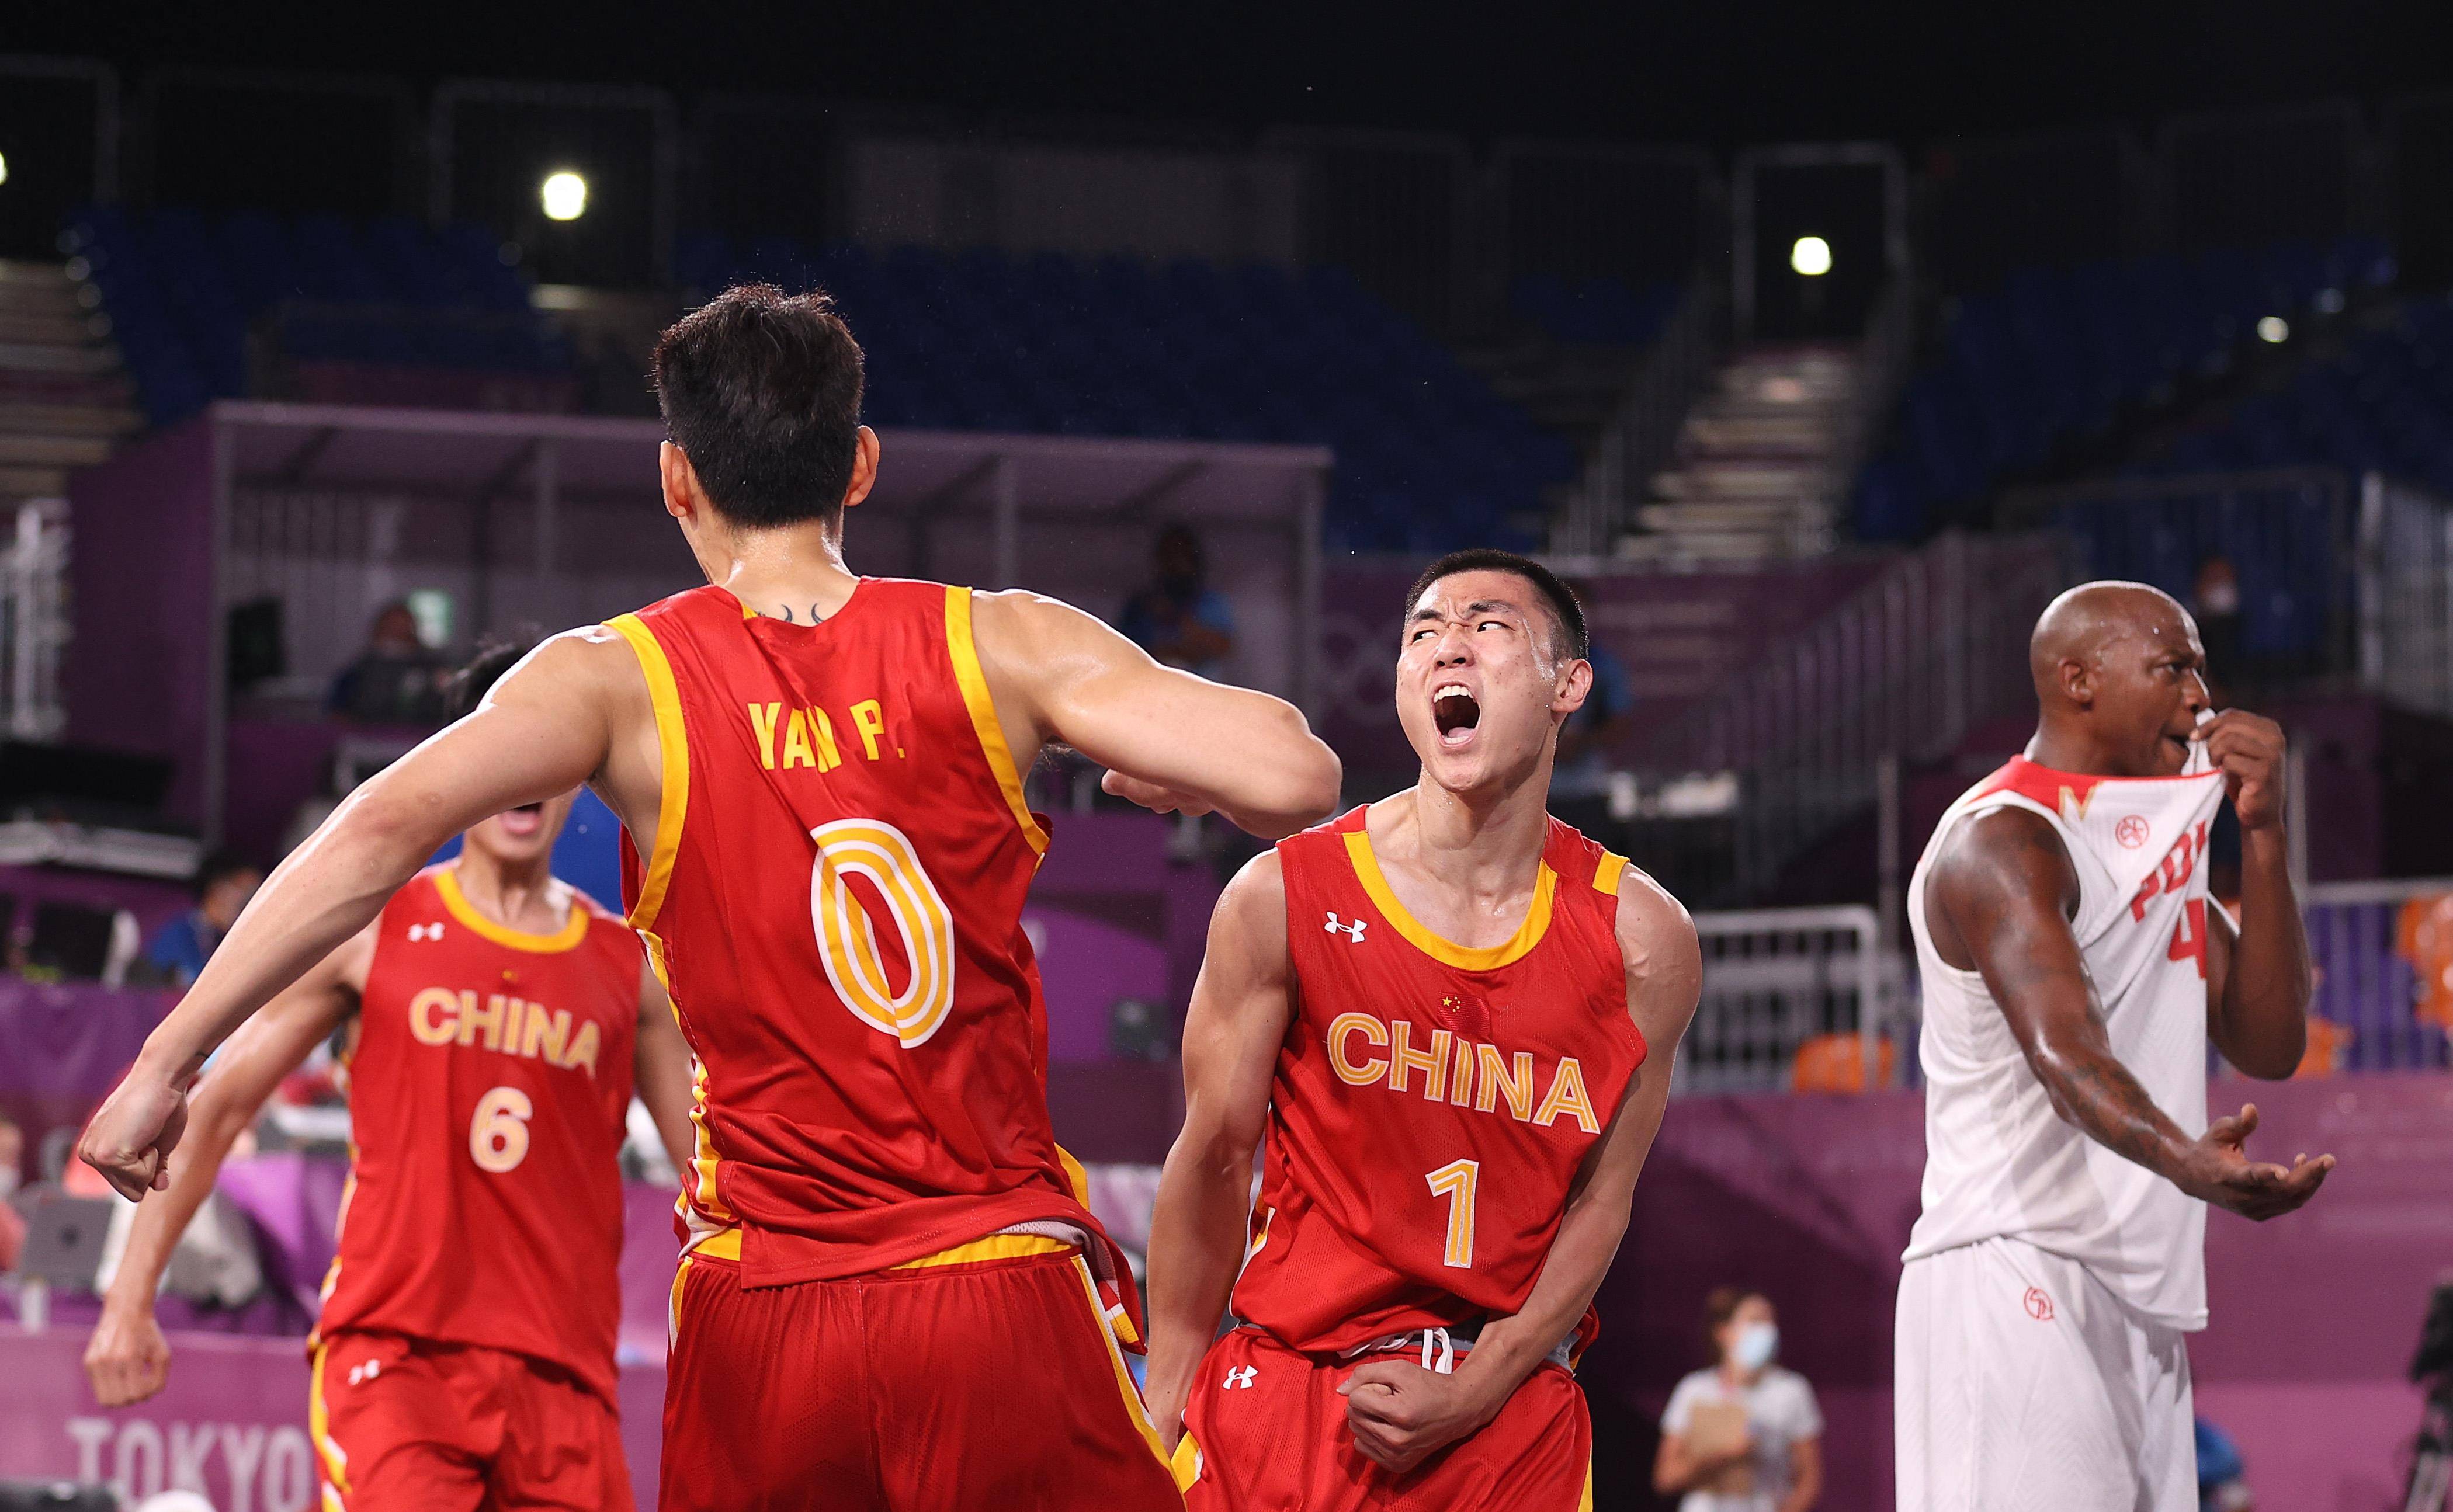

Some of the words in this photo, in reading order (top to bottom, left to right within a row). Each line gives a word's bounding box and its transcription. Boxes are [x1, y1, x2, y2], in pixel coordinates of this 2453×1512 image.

[748, 701, 842, 773] YAN
[810, 818, 955, 1049] 0
[408, 986, 601, 1080] CHINA
[1327, 1012, 1601, 1135] CHINA
[469, 1086, 533, 1173] 6
[1424, 1158, 1480, 1269] 1
[65, 1416, 314, 1512] TOKYO
